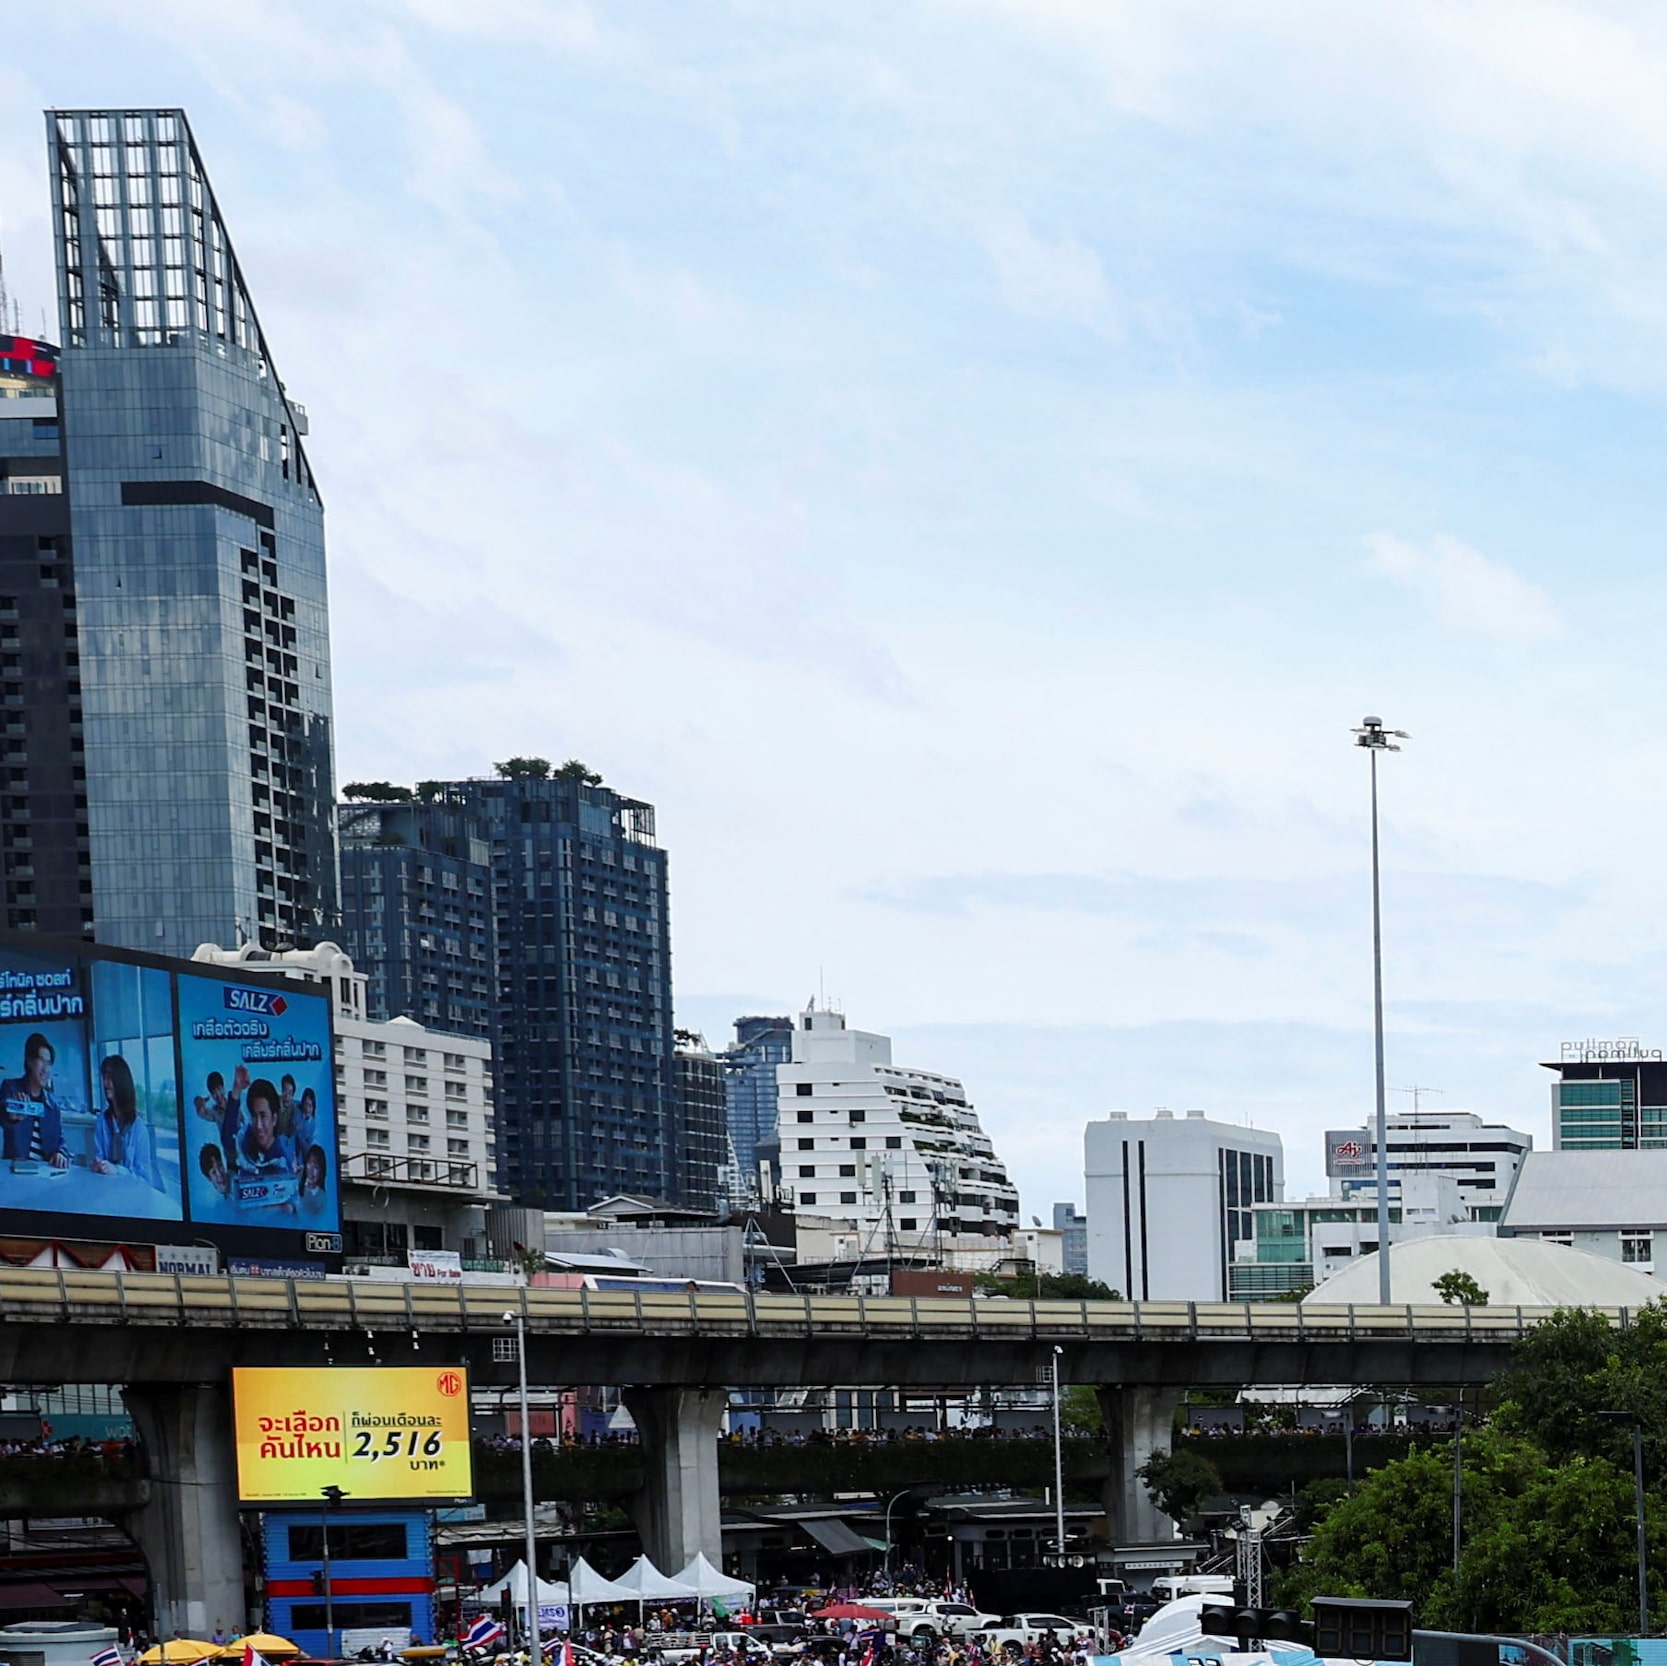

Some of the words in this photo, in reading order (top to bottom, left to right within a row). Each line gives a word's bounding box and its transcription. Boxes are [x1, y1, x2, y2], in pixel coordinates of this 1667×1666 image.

[229, 989, 268, 1013] SALZ
[411, 1262, 436, 1277] ขาย
[438, 1374, 460, 1395] MG
[258, 1410, 339, 1432] จะเลือก
[351, 1411, 442, 1427] ก็ผ่อนเดือนละ
[260, 1434, 341, 1459] คันไหน
[352, 1431, 441, 1462] 2,516
